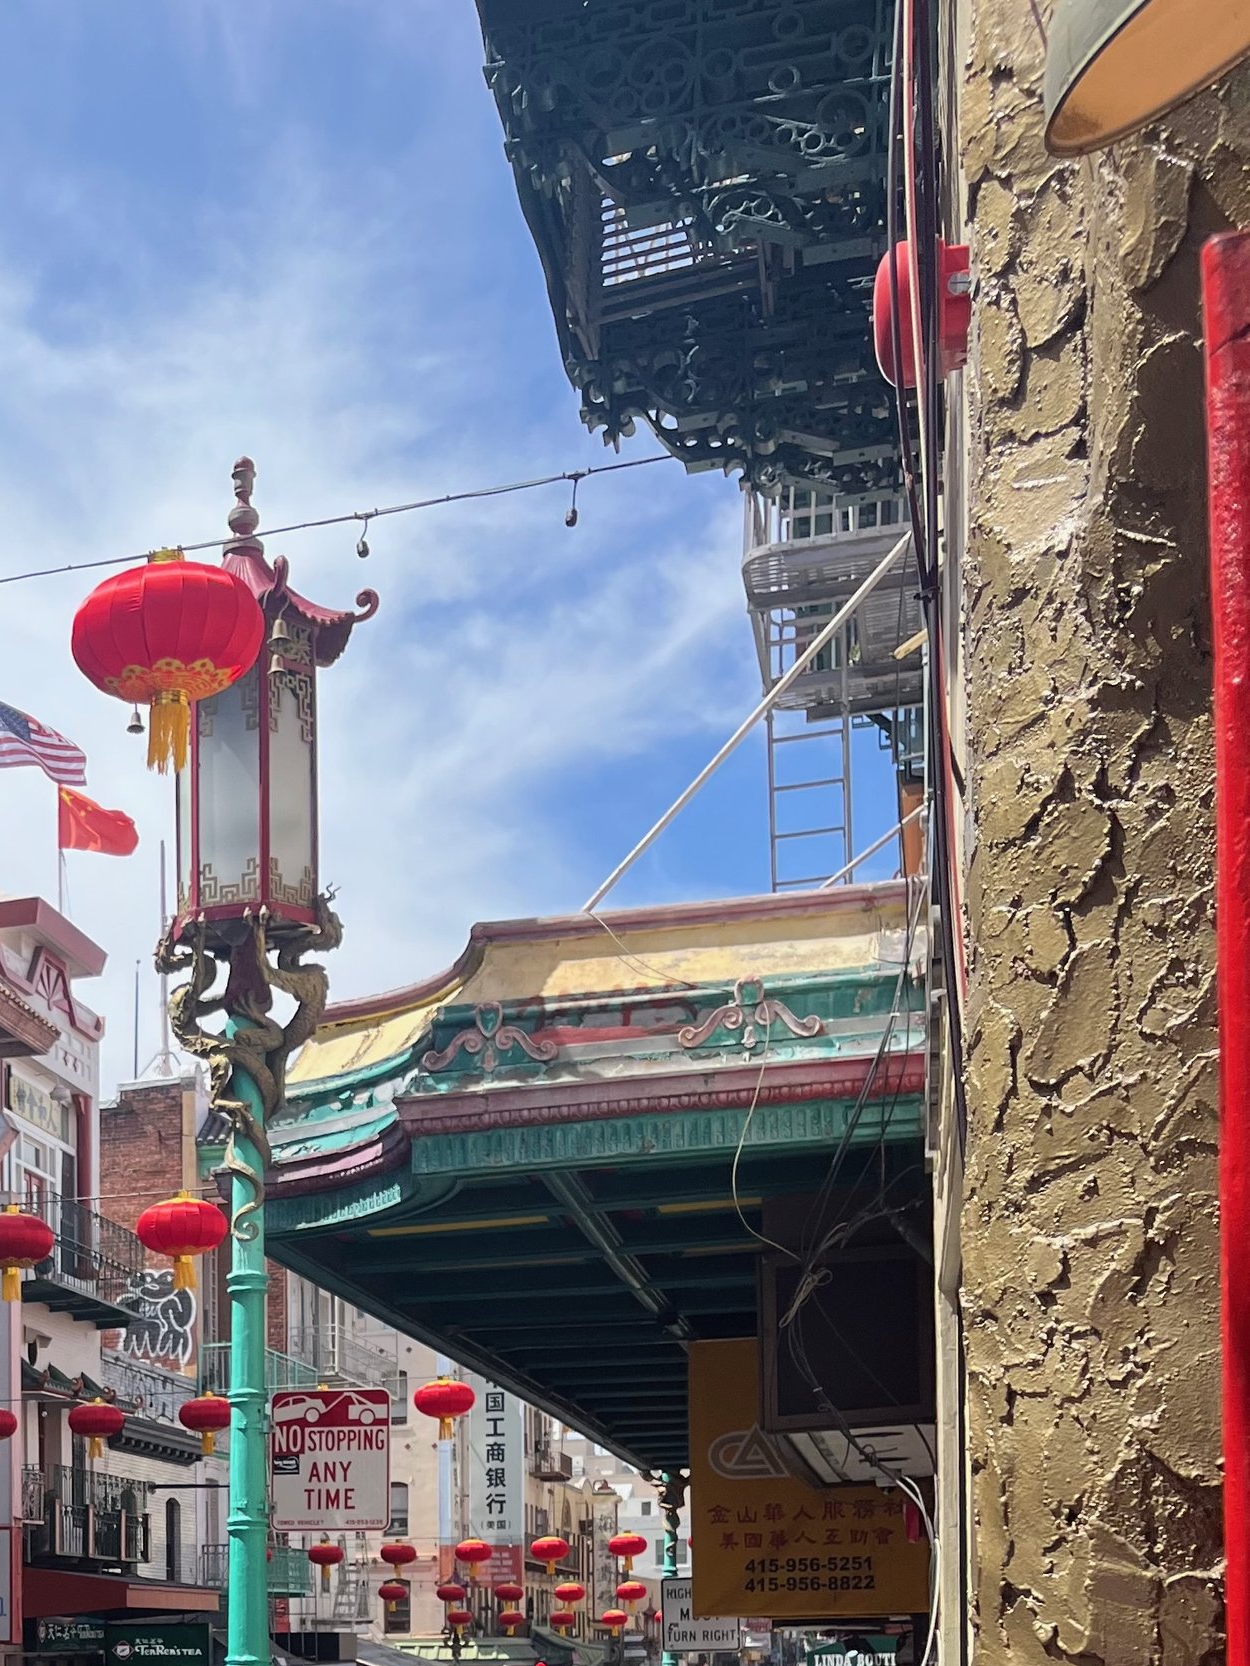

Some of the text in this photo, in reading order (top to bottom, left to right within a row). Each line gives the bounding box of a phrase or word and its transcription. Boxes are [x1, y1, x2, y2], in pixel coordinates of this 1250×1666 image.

[275, 1425, 385, 1453] NO STOPPING
[308, 1461, 352, 1483] ANY
[304, 1488, 355, 1510] TIME
[744, 1556, 873, 1573] 415-956-5251
[744, 1575, 876, 1592] 415-956-8822
[666, 1588, 692, 1599] RIGH
[669, 1630, 736, 1642] TURN RIGHT
[181, 1648, 203, 1656] TEA
